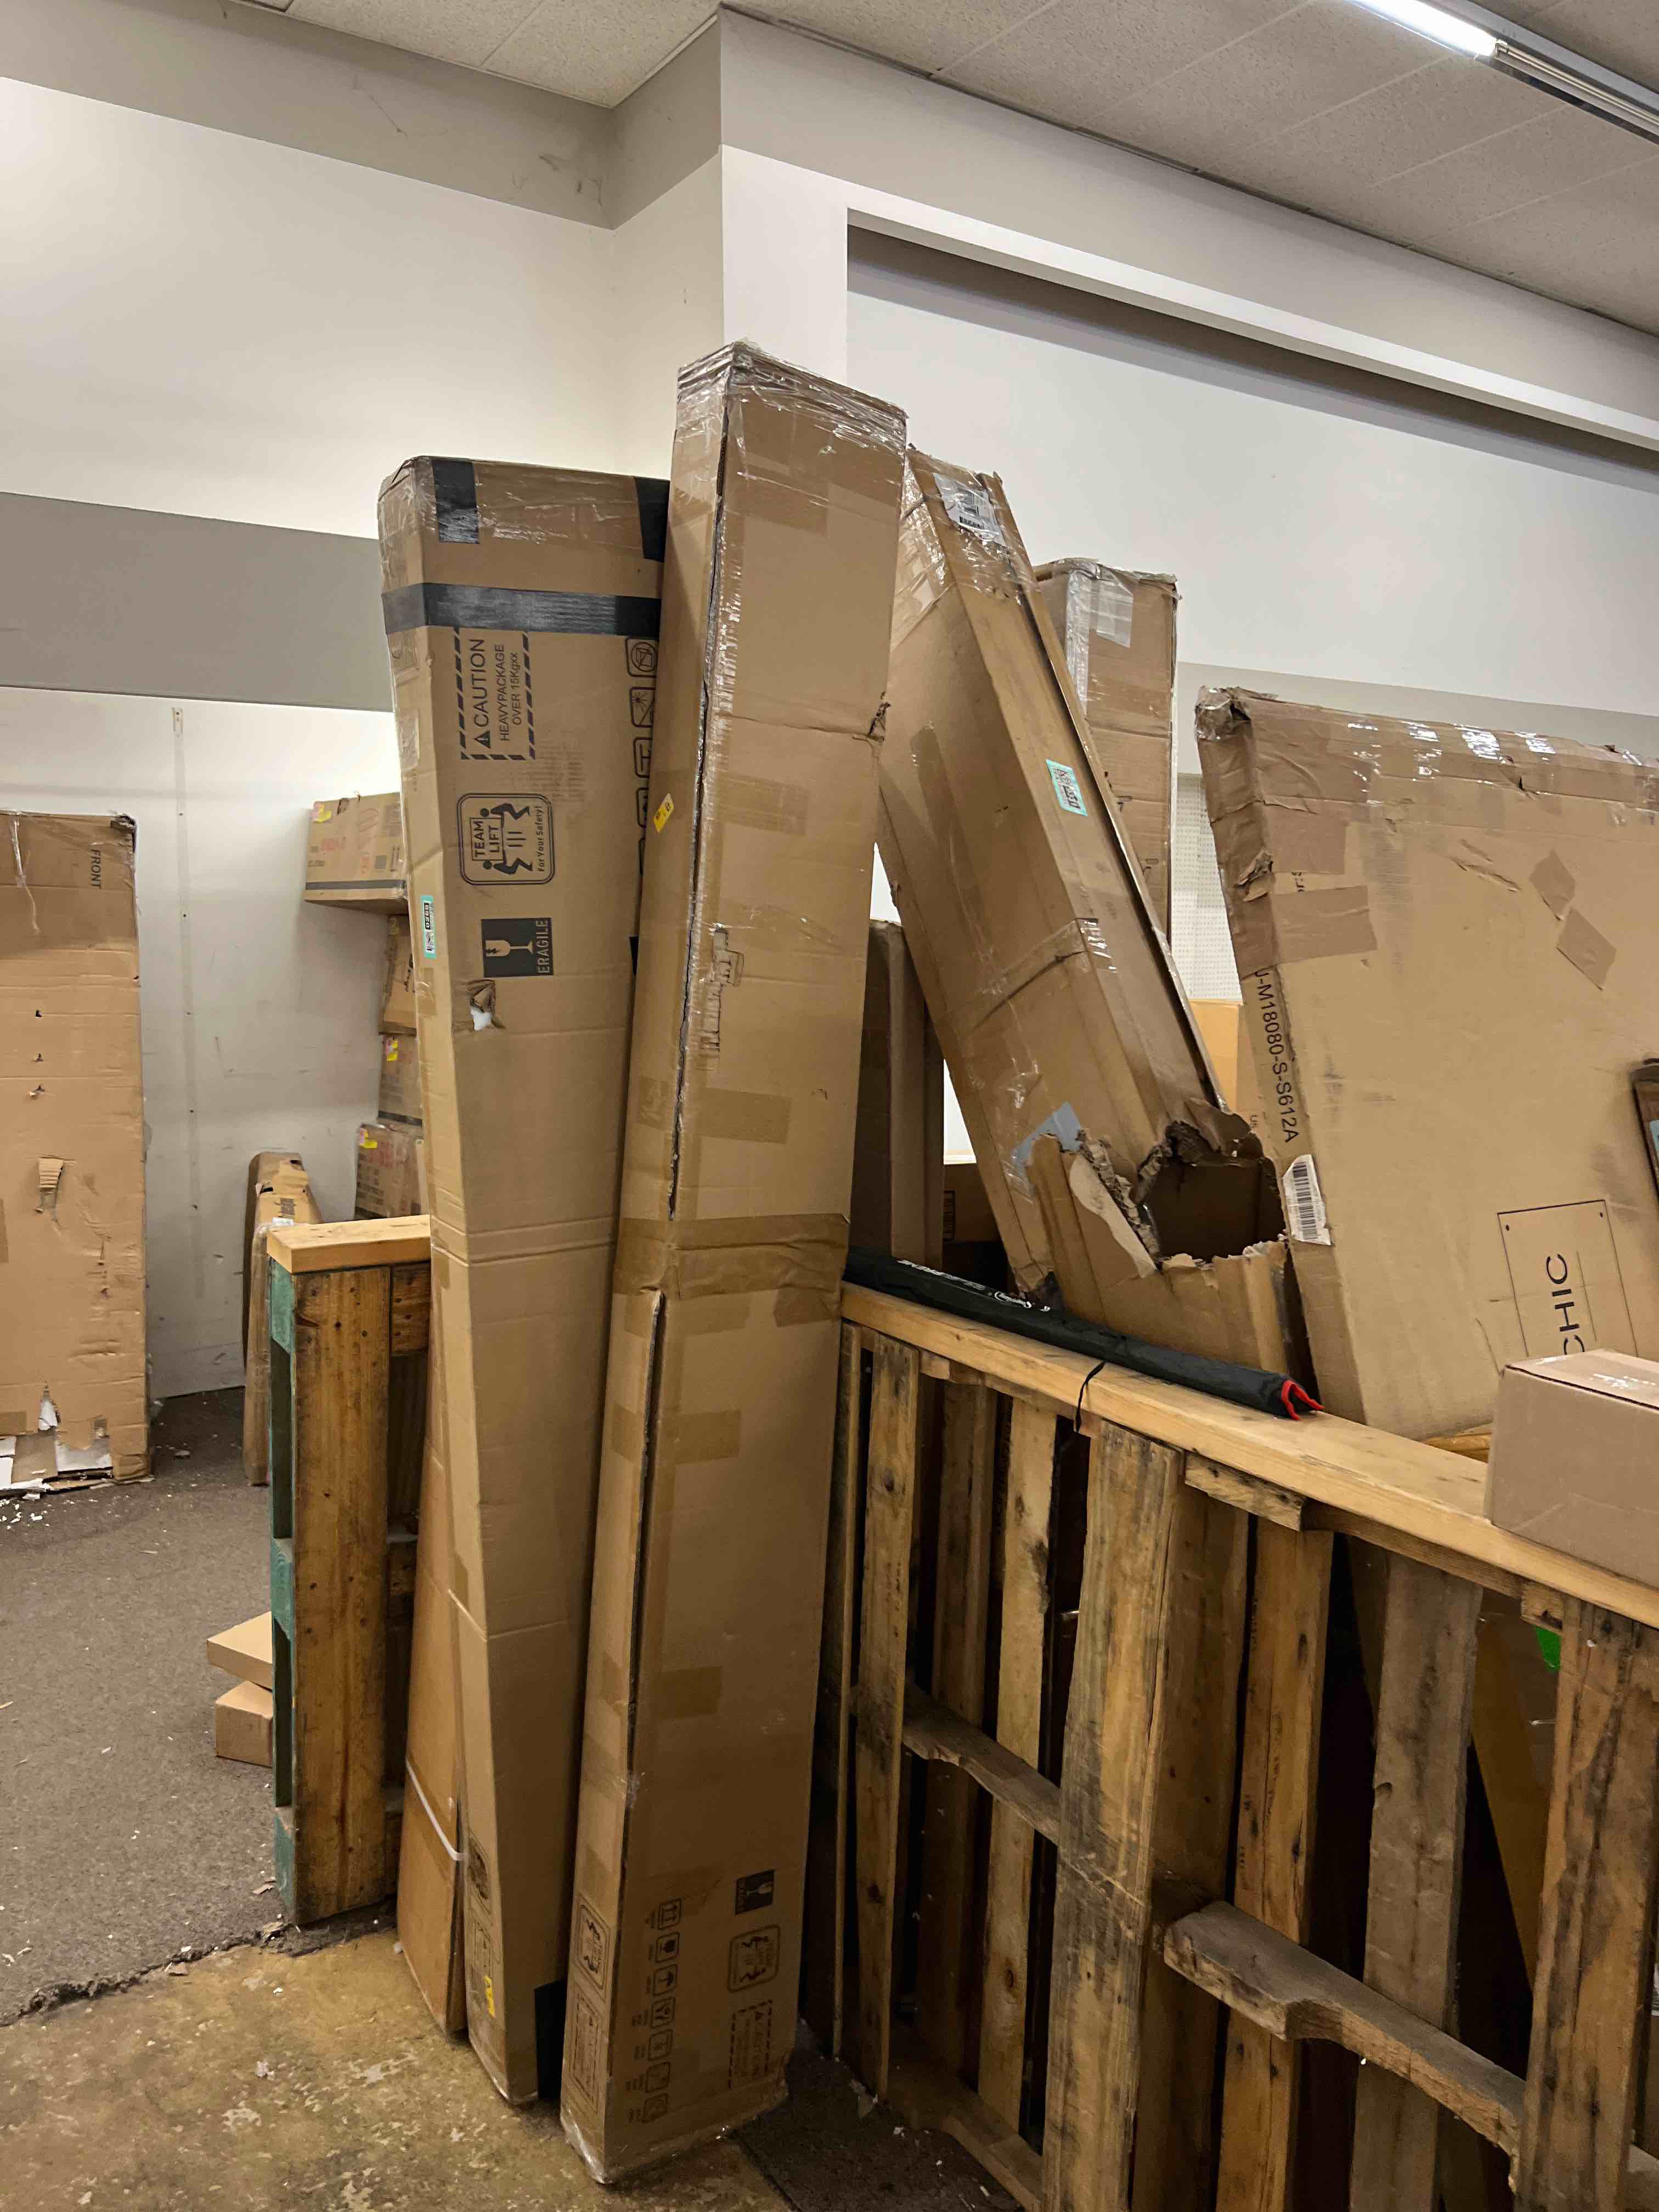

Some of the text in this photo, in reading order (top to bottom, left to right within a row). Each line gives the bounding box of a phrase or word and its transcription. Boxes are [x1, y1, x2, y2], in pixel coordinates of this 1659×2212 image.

[469, 639, 489, 727] CAUTION
[512, 693, 522, 725] OVER
[535, 806, 544, 836] Safety!
[474, 821, 485, 857] TEAM
[489, 825, 499, 853] LIFT
[92, 850, 101, 889] FRONT
